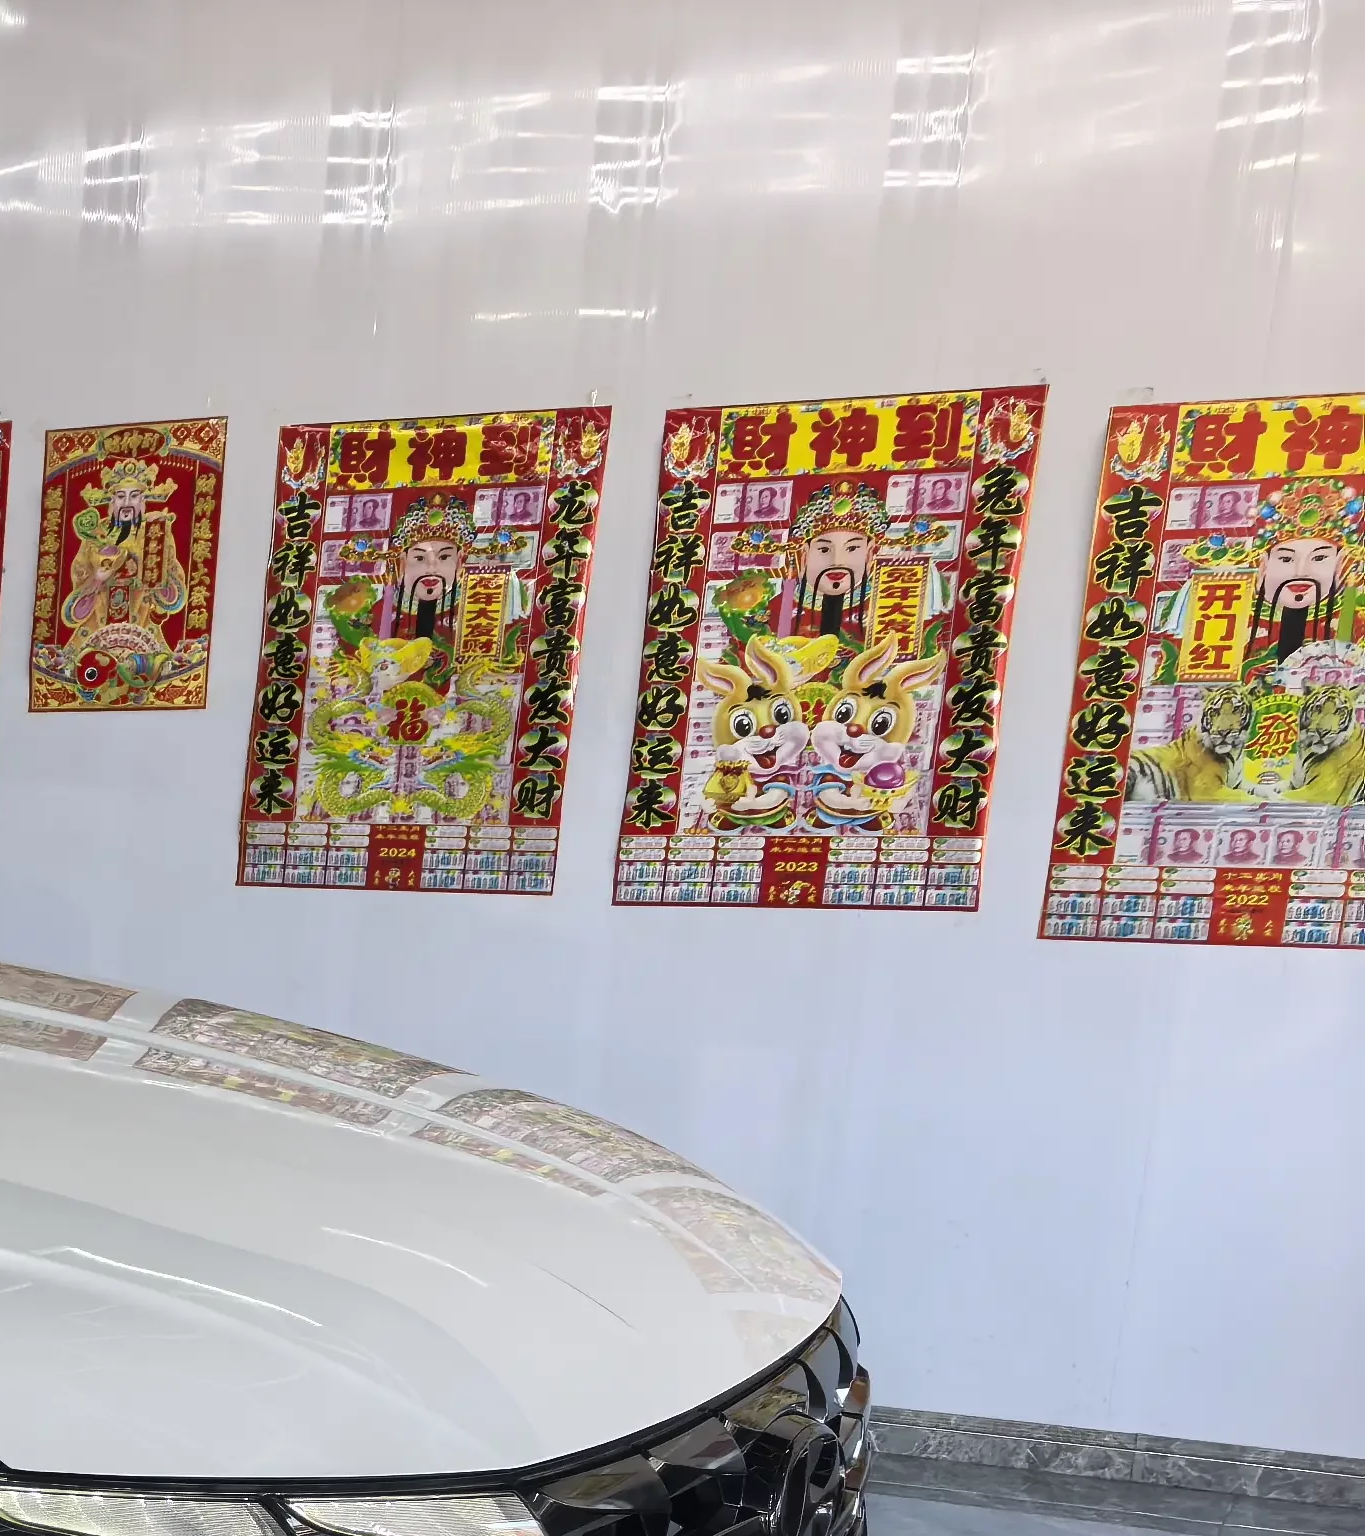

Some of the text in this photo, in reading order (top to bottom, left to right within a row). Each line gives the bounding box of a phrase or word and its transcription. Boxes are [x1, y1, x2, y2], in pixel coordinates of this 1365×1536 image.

[336, 422, 542, 486] 財神到
[727, 401, 964, 473] 財神到
[251, 491, 321, 815] 吉祥如意好运来
[514, 481, 594, 818] 龙年富贵发大财
[627, 480, 710, 829] 吉祥如意好运来
[933, 464, 1024, 830] 兔年富贵发大财
[1188, 583, 1242, 670] 开门红
[1055, 485, 1164, 856] 吉祥如意好运来
[387, 697, 429, 741] 福
[379, 847, 416, 857] 2024
[774, 861, 818, 872] 2023
[1226, 894, 1269, 906] 2022
